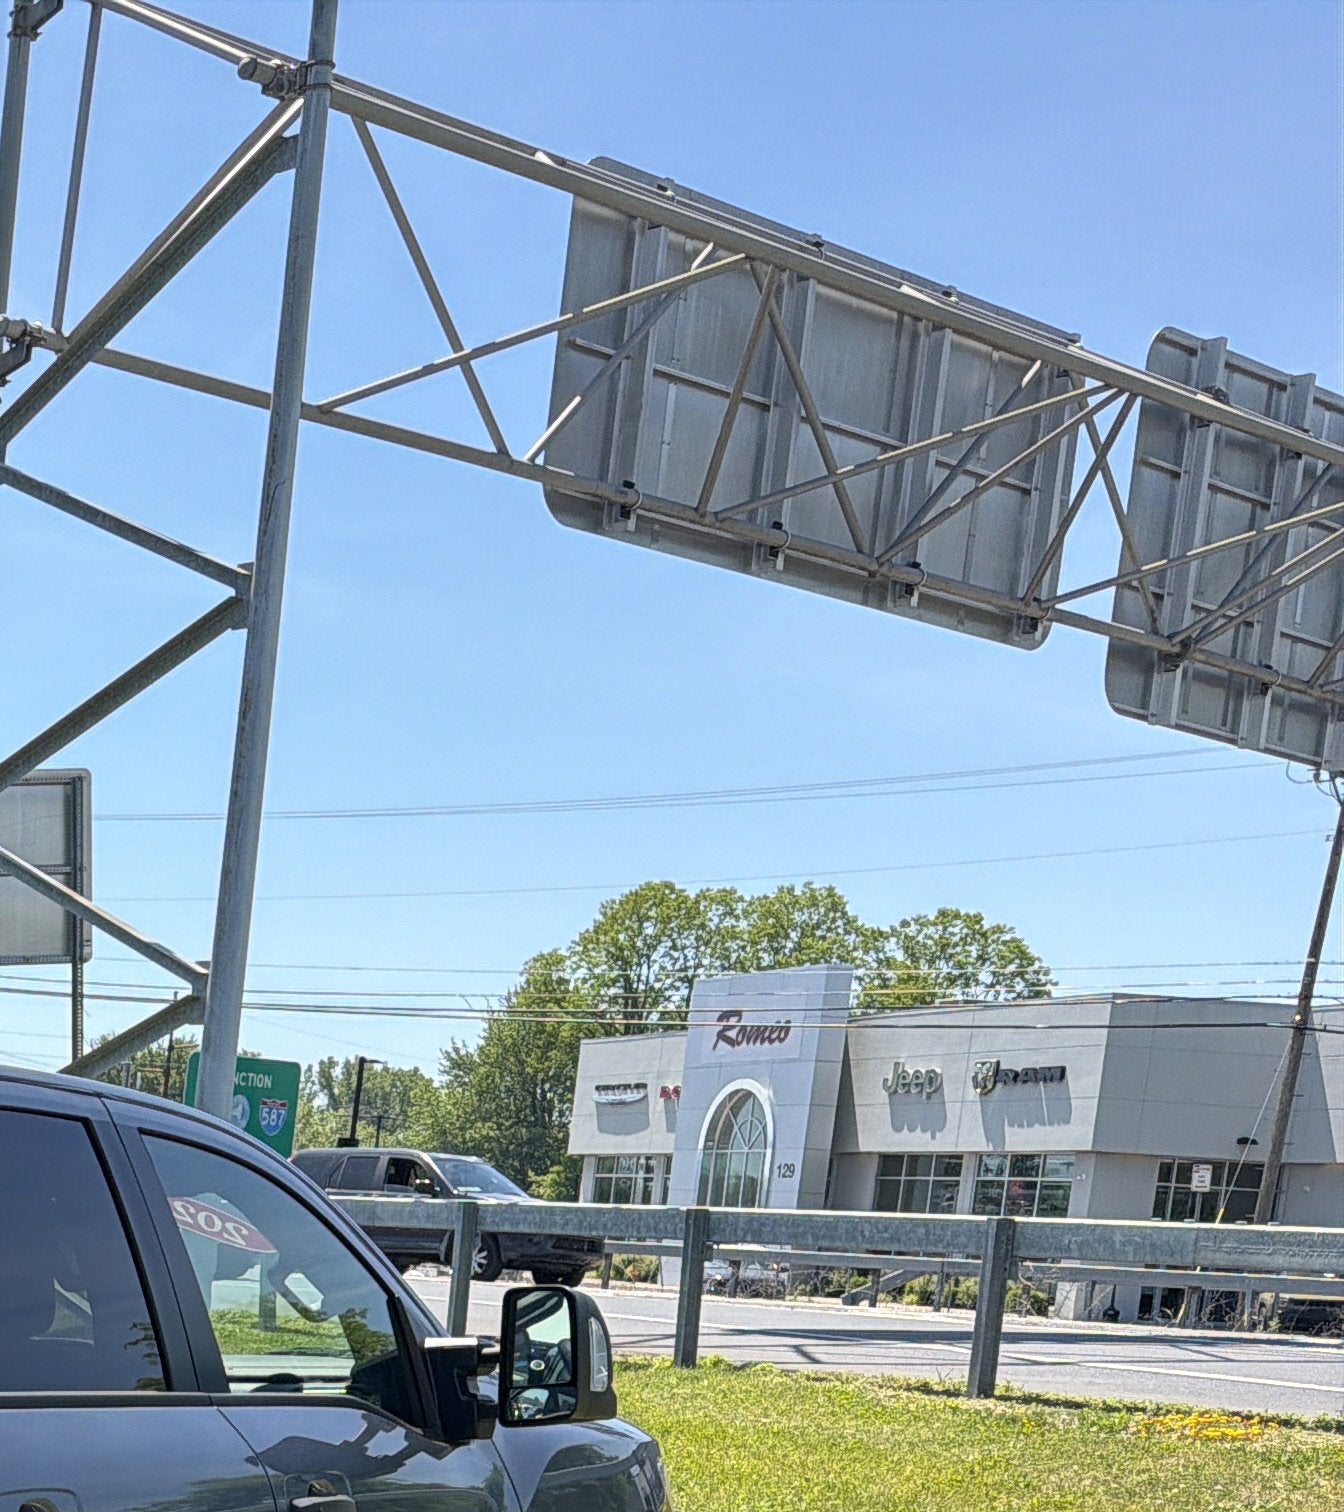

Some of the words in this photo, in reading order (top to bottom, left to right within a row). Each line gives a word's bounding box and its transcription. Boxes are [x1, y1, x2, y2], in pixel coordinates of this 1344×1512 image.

[712, 1009, 792, 1052] Romeo
[883, 1061, 942, 1100] Jeep
[998, 1066, 1067, 1085] RAM
[261, 1107, 286, 1126] 587
[775, 1162, 796, 1179] 129
